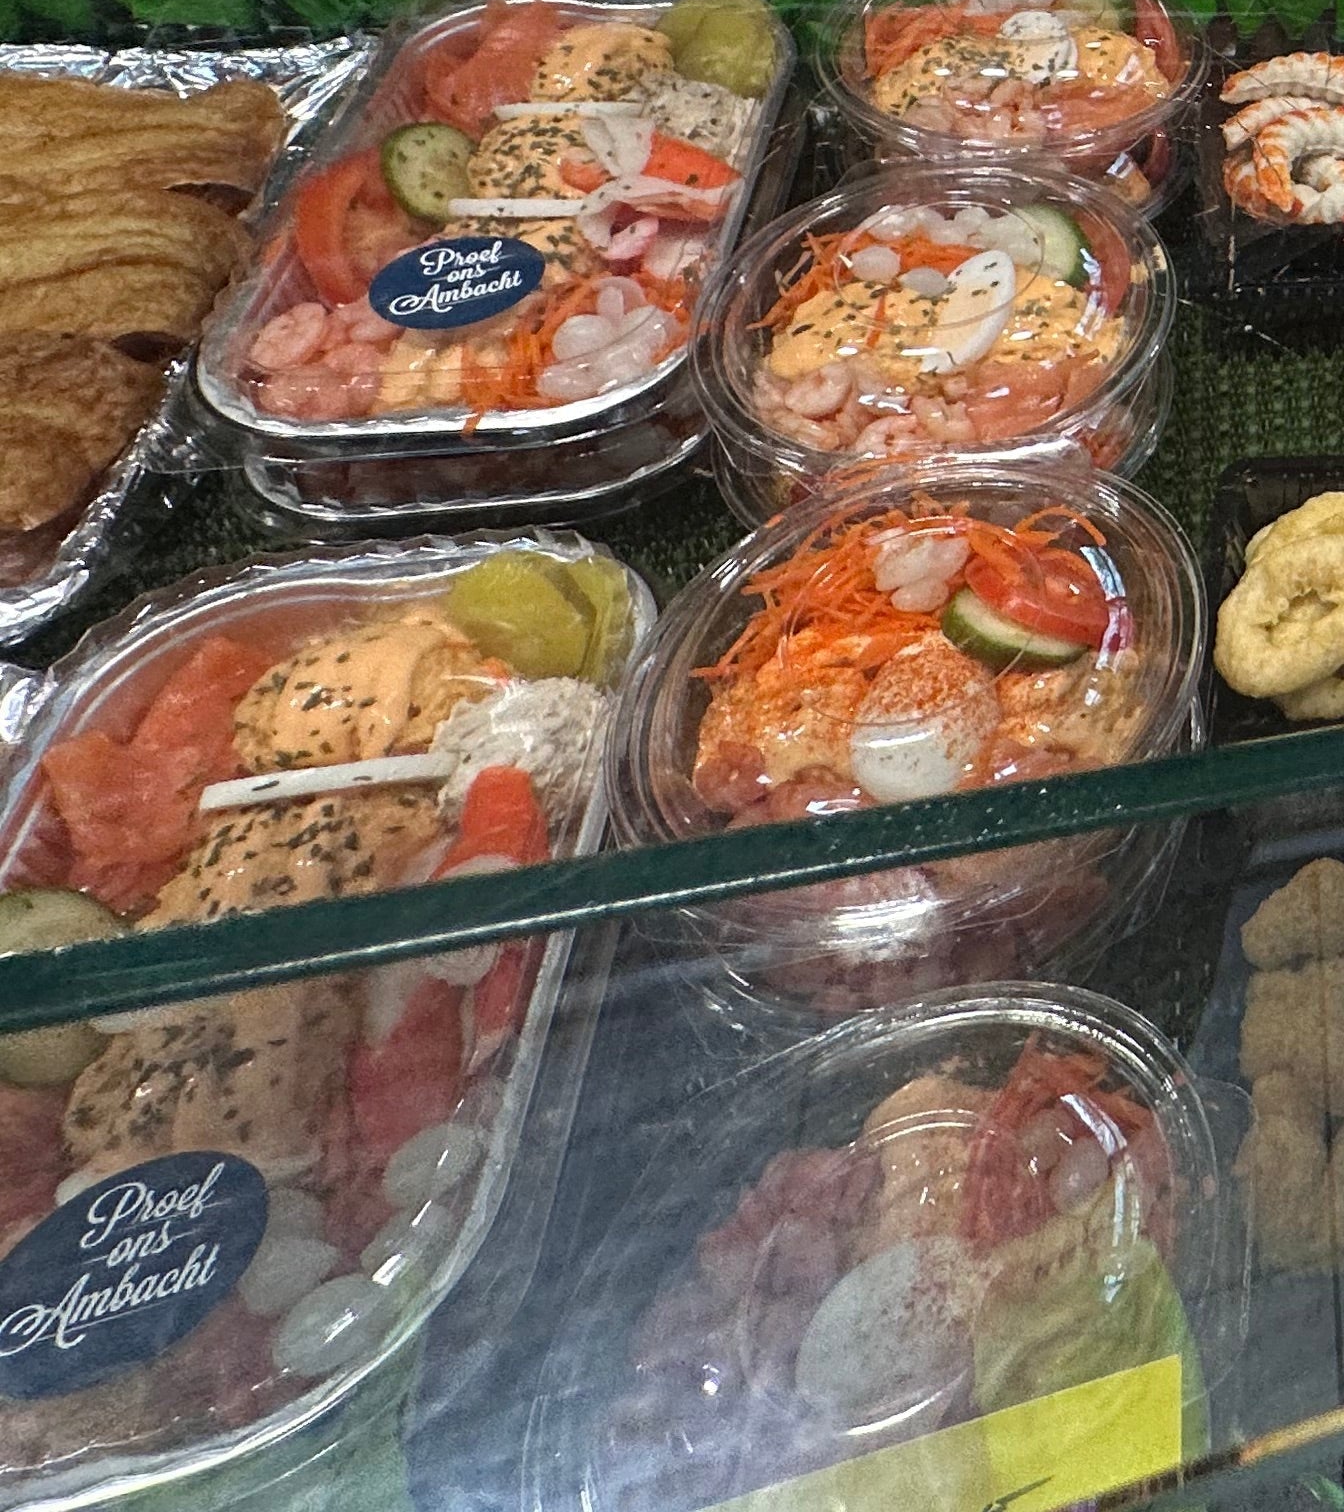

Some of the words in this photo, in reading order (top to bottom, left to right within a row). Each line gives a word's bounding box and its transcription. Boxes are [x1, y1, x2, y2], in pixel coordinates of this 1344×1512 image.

[420, 240, 502, 276] Proef
[447, 264, 487, 283] ons
[388, 270, 523, 316] Ambacht
[80, 1161, 226, 1249] Proef
[106, 1220, 174, 1269] ons
[0, 1243, 221, 1358] Ambacht
